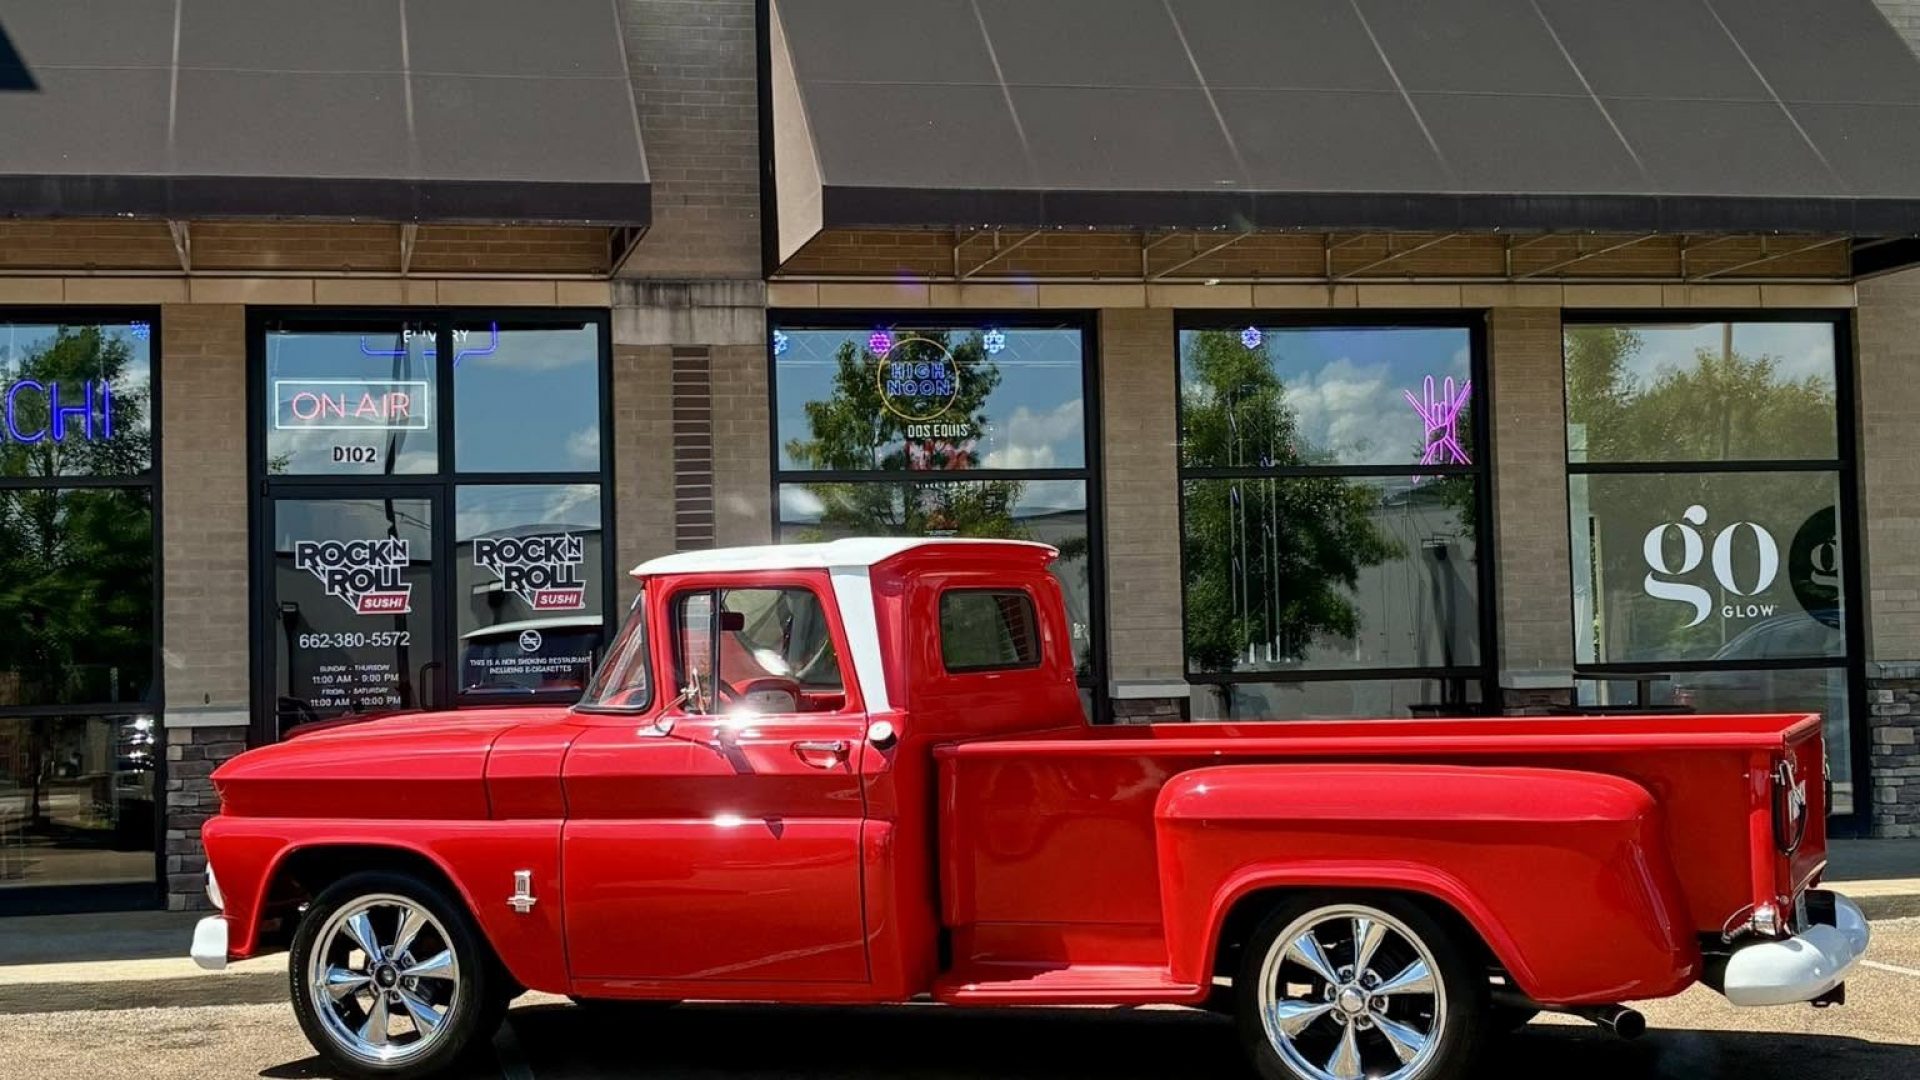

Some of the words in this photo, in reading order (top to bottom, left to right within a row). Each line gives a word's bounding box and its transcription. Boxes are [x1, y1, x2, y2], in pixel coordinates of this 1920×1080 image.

[891, 362, 945, 379] HIGH
[887, 380, 951, 396] NOON
[0, 379, 112, 442] CHI
[291, 391, 345, 419] ON
[355, 392, 410, 417] AIR
[907, 424, 931, 438] DOS
[933, 423, 969, 437] EQUIS
[333, 446, 376, 463] D102
[1643, 504, 1779, 629] go
[325, 566, 411, 595] ROLL
[503, 563, 587, 592] ROLL
[364, 598, 403, 609] SUSHI
[540, 594, 577, 605] SUSHI
[299, 631, 411, 649] 662-380-5572
[354, 664, 391, 672] THURSDAY
[312, 675, 334, 684] 11:00
[336, 674, 352, 683] AM
[361, 674, 381, 682] 9:00
[384, 673, 400, 682] PM
[310, 698, 332, 707] 11:00
[334, 698, 350, 706] AM
[360, 697, 384, 706] 10:00
[386, 696, 401, 705] PM
